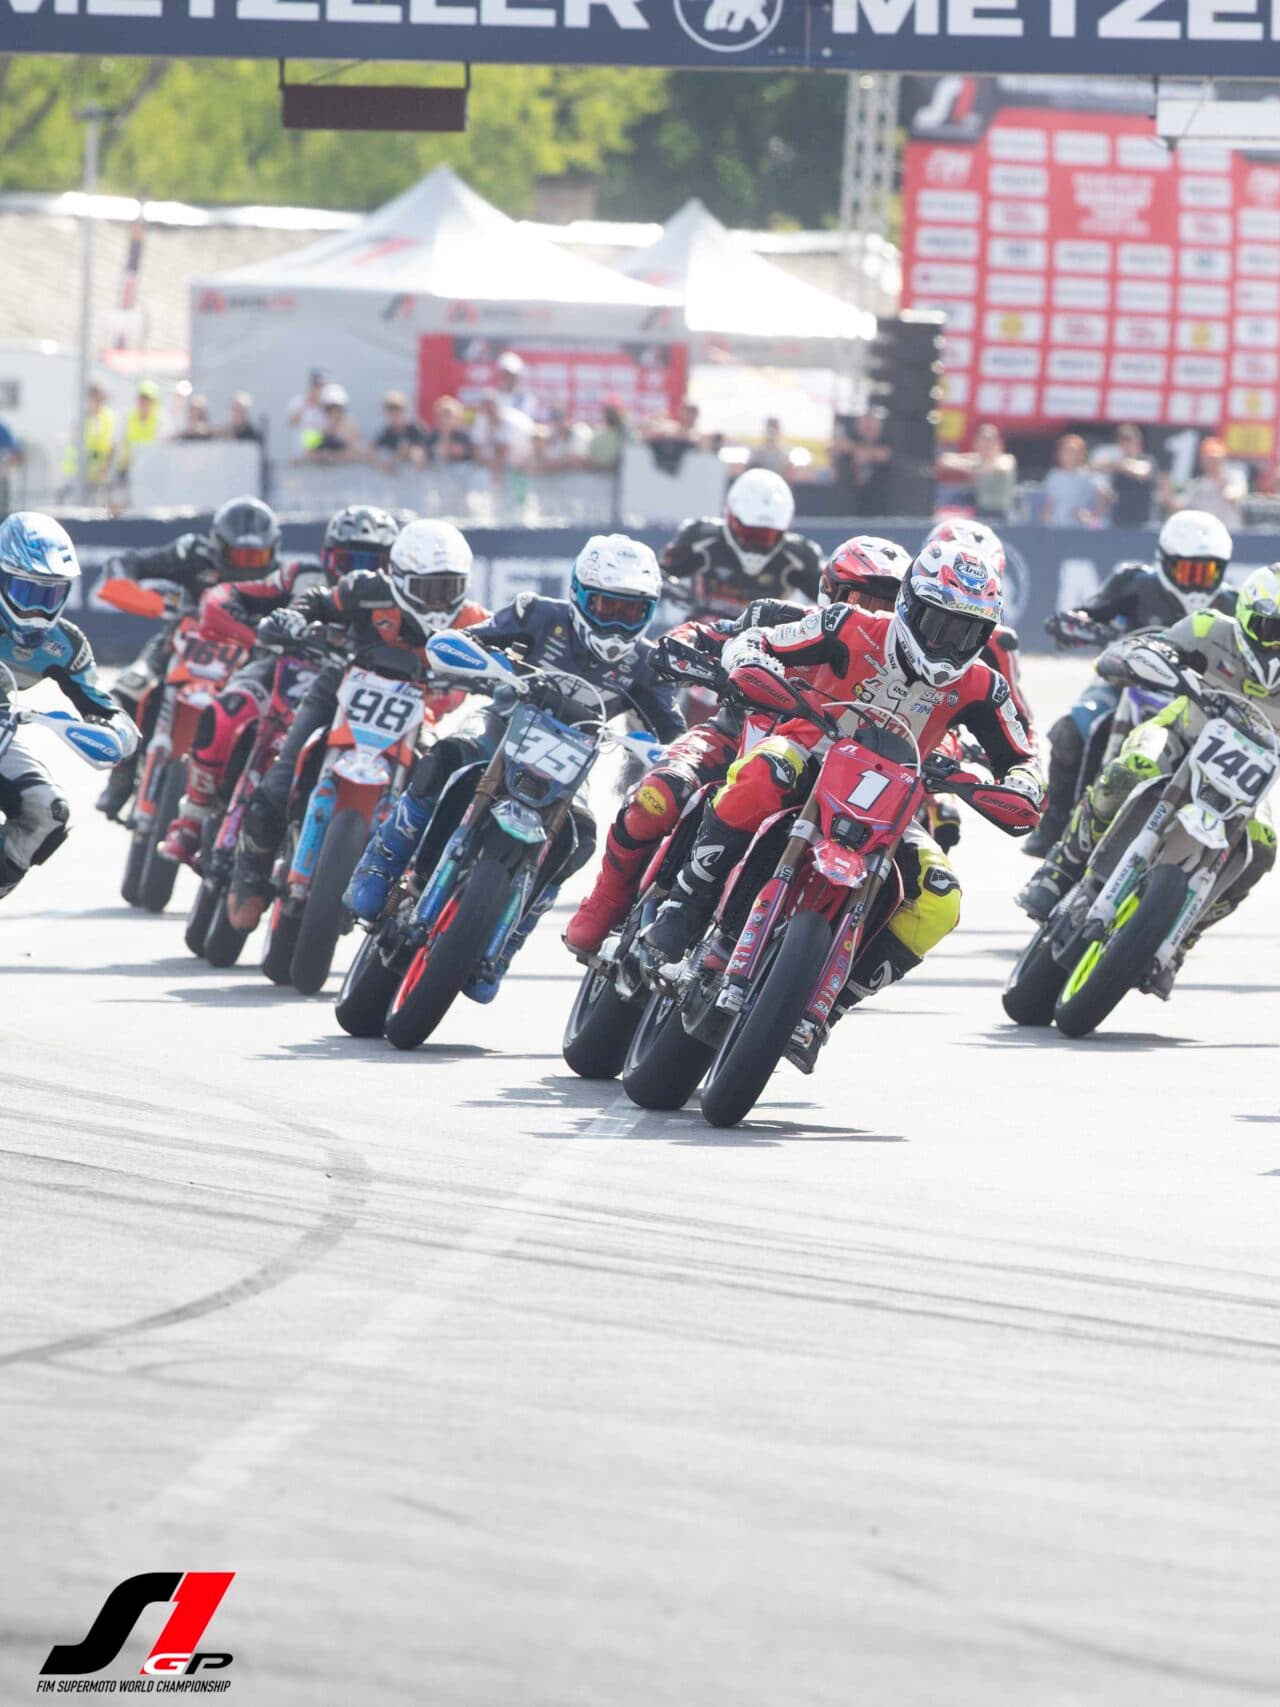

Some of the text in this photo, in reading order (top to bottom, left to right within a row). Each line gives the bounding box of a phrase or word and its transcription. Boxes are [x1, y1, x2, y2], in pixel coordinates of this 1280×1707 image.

[346, 687, 415, 733] 98
[504, 726, 589, 785] 35
[1197, 736, 1276, 796] 140
[847, 770, 891, 810] 1
